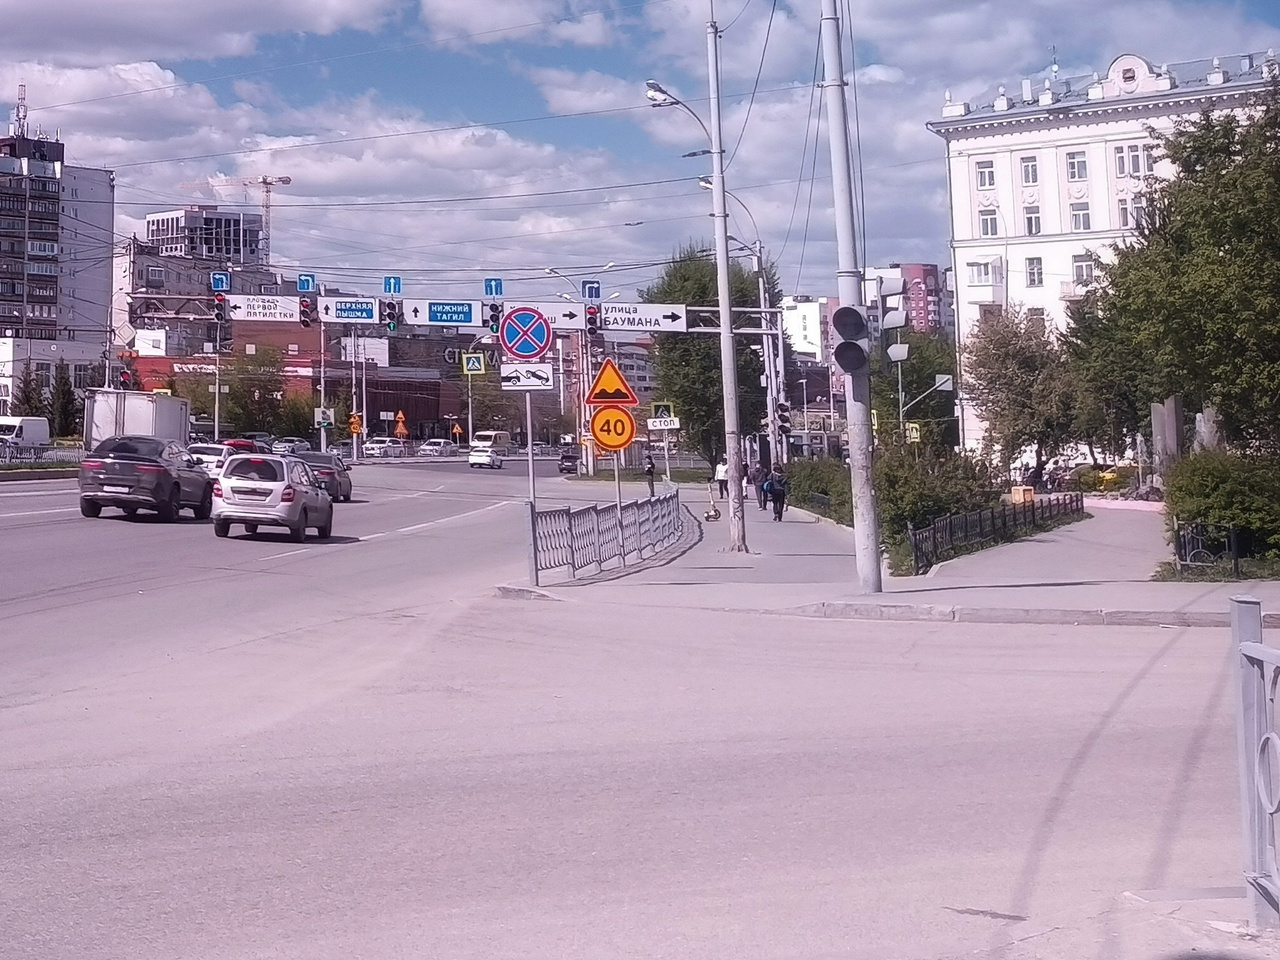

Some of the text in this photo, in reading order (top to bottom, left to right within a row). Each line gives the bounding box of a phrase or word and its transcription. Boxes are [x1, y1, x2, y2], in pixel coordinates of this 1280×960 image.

[336, 302, 372, 310] ВЕРХНЯЯ
[431, 304, 469, 313] НИЖНИЙ
[604, 306, 638, 314] улица
[247, 311, 294, 319] ПЯТИЛЕТКИ
[436, 313, 465, 321] ТАГИЛ
[604, 317, 661, 327] БАУМАНА
[599, 419, 626, 436] 40
[651, 420, 675, 428] СТОП
